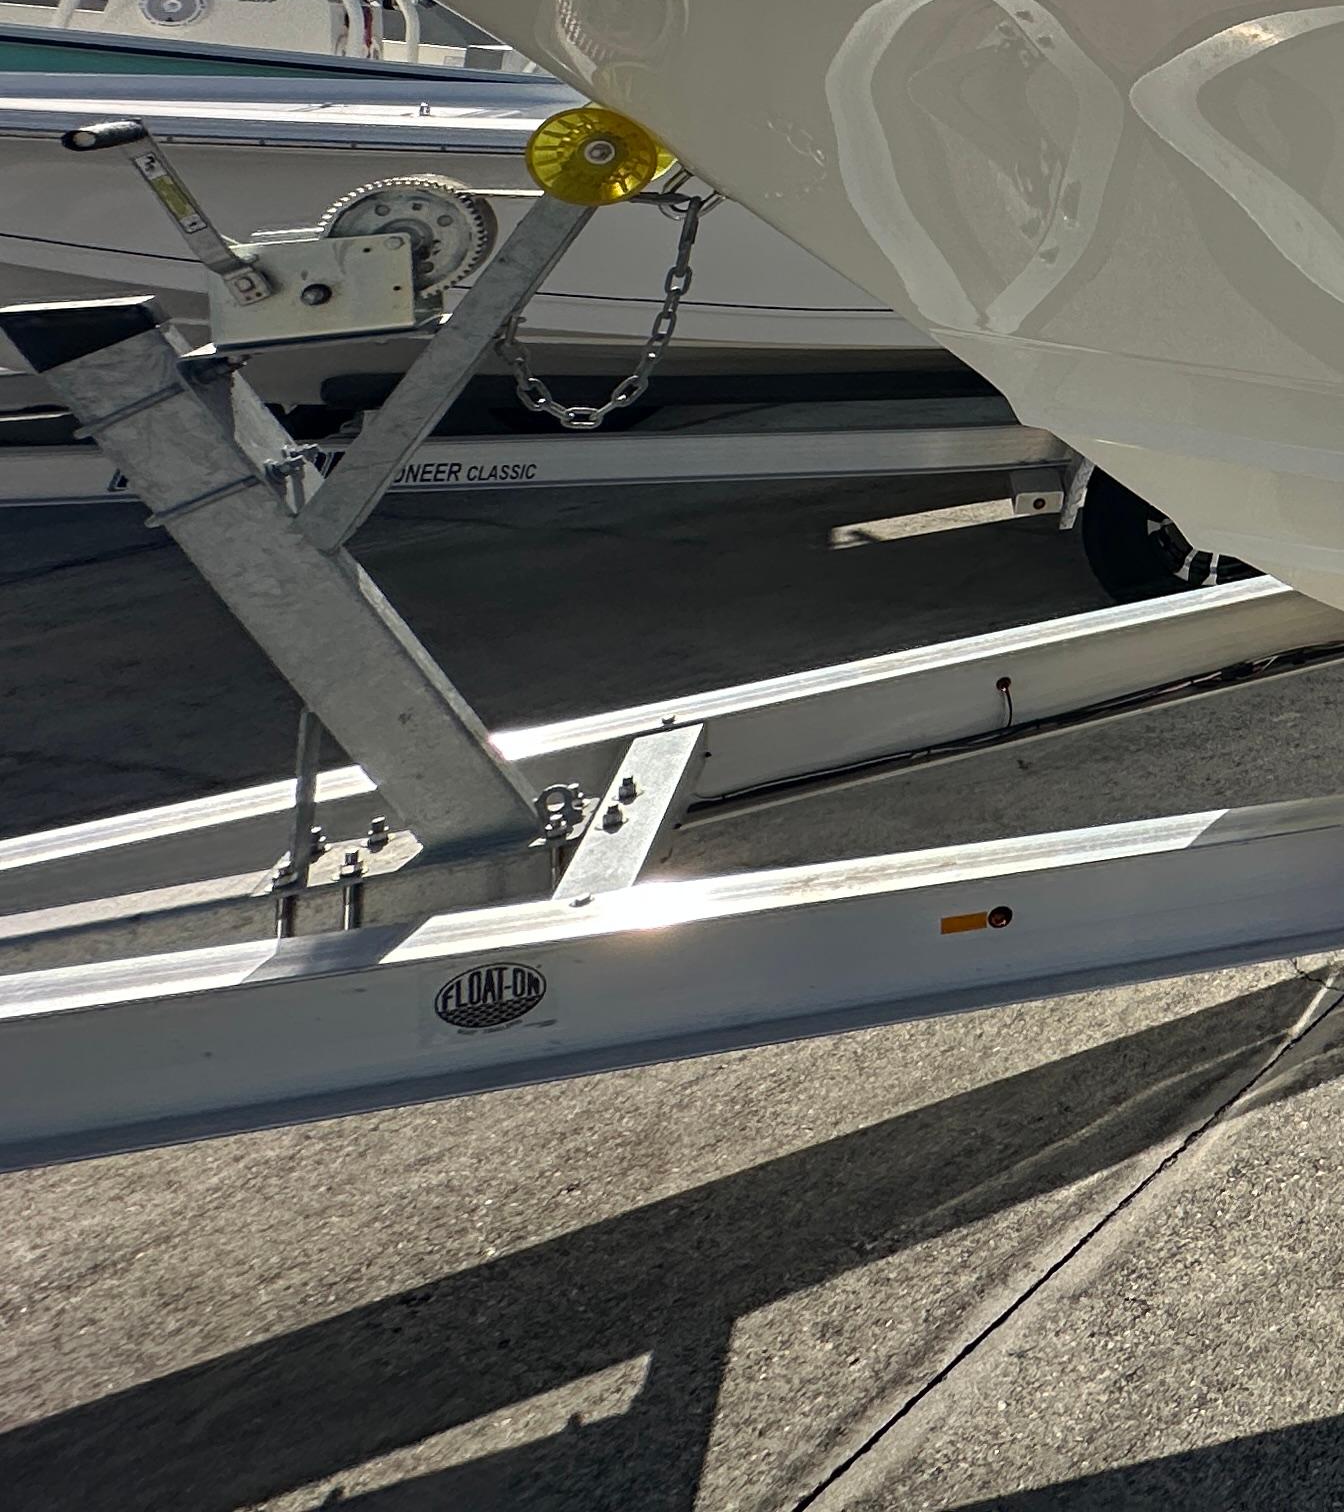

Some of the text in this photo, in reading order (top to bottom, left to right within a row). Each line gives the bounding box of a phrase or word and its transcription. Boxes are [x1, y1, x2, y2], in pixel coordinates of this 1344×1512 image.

[394, 462, 537, 483] NEER CLASSIC
[441, 966, 541, 1011] FLOAT-ON
